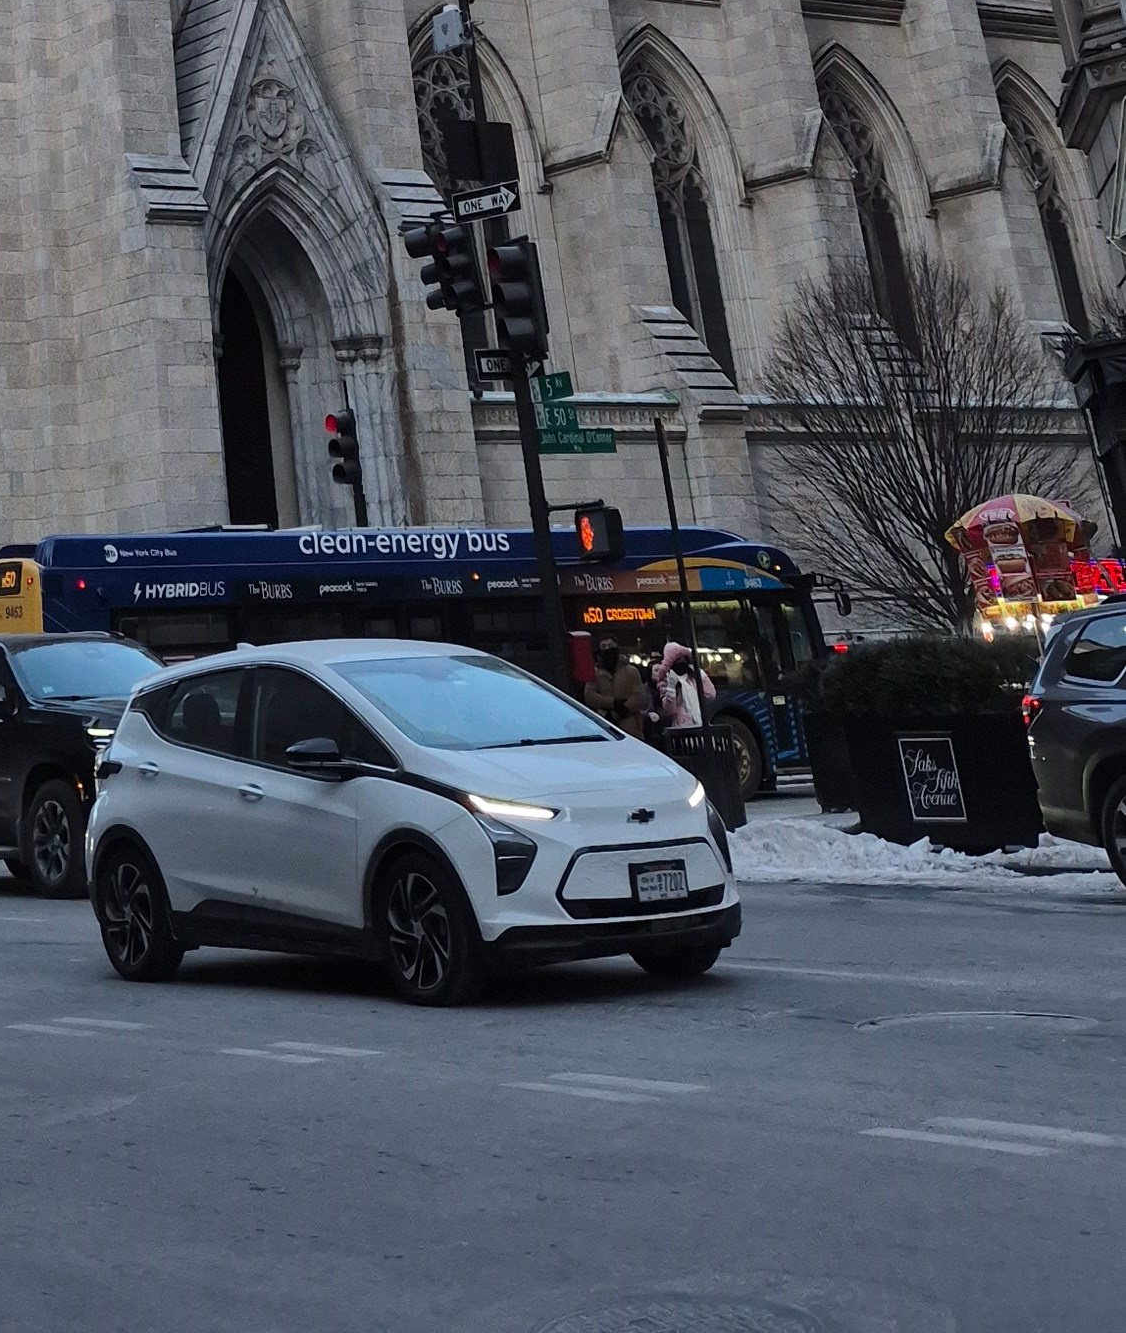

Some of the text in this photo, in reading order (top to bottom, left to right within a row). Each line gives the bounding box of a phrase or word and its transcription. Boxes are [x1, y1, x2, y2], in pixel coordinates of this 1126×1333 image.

[463, 193, 510, 213] ONE WAY
[486, 359, 506, 372] ONE
[545, 379, 553, 397] 5
[554, 407, 567, 426] 50
[541, 432, 557, 445] John
[558, 431, 584, 445] Cardinal
[298, 530, 511, 559] clean-energy bus
[119, 549, 134, 558] New
[134, 549, 150, 558] York
[150, 548, 164, 558] City
[248, 583, 260, 595] The
[319, 580, 354, 597] peacock
[486, 577, 520, 593] peacock
[636, 574, 667, 589] peacock
[743, 576, 763, 589] 9463
[5, 605, 24, 620] 9463
[605, 607, 657, 622] CROSSTOWN
[904, 748, 938, 779] Saks
[926, 768, 960, 794] Fifth
[911, 782, 958, 810] Avenue
